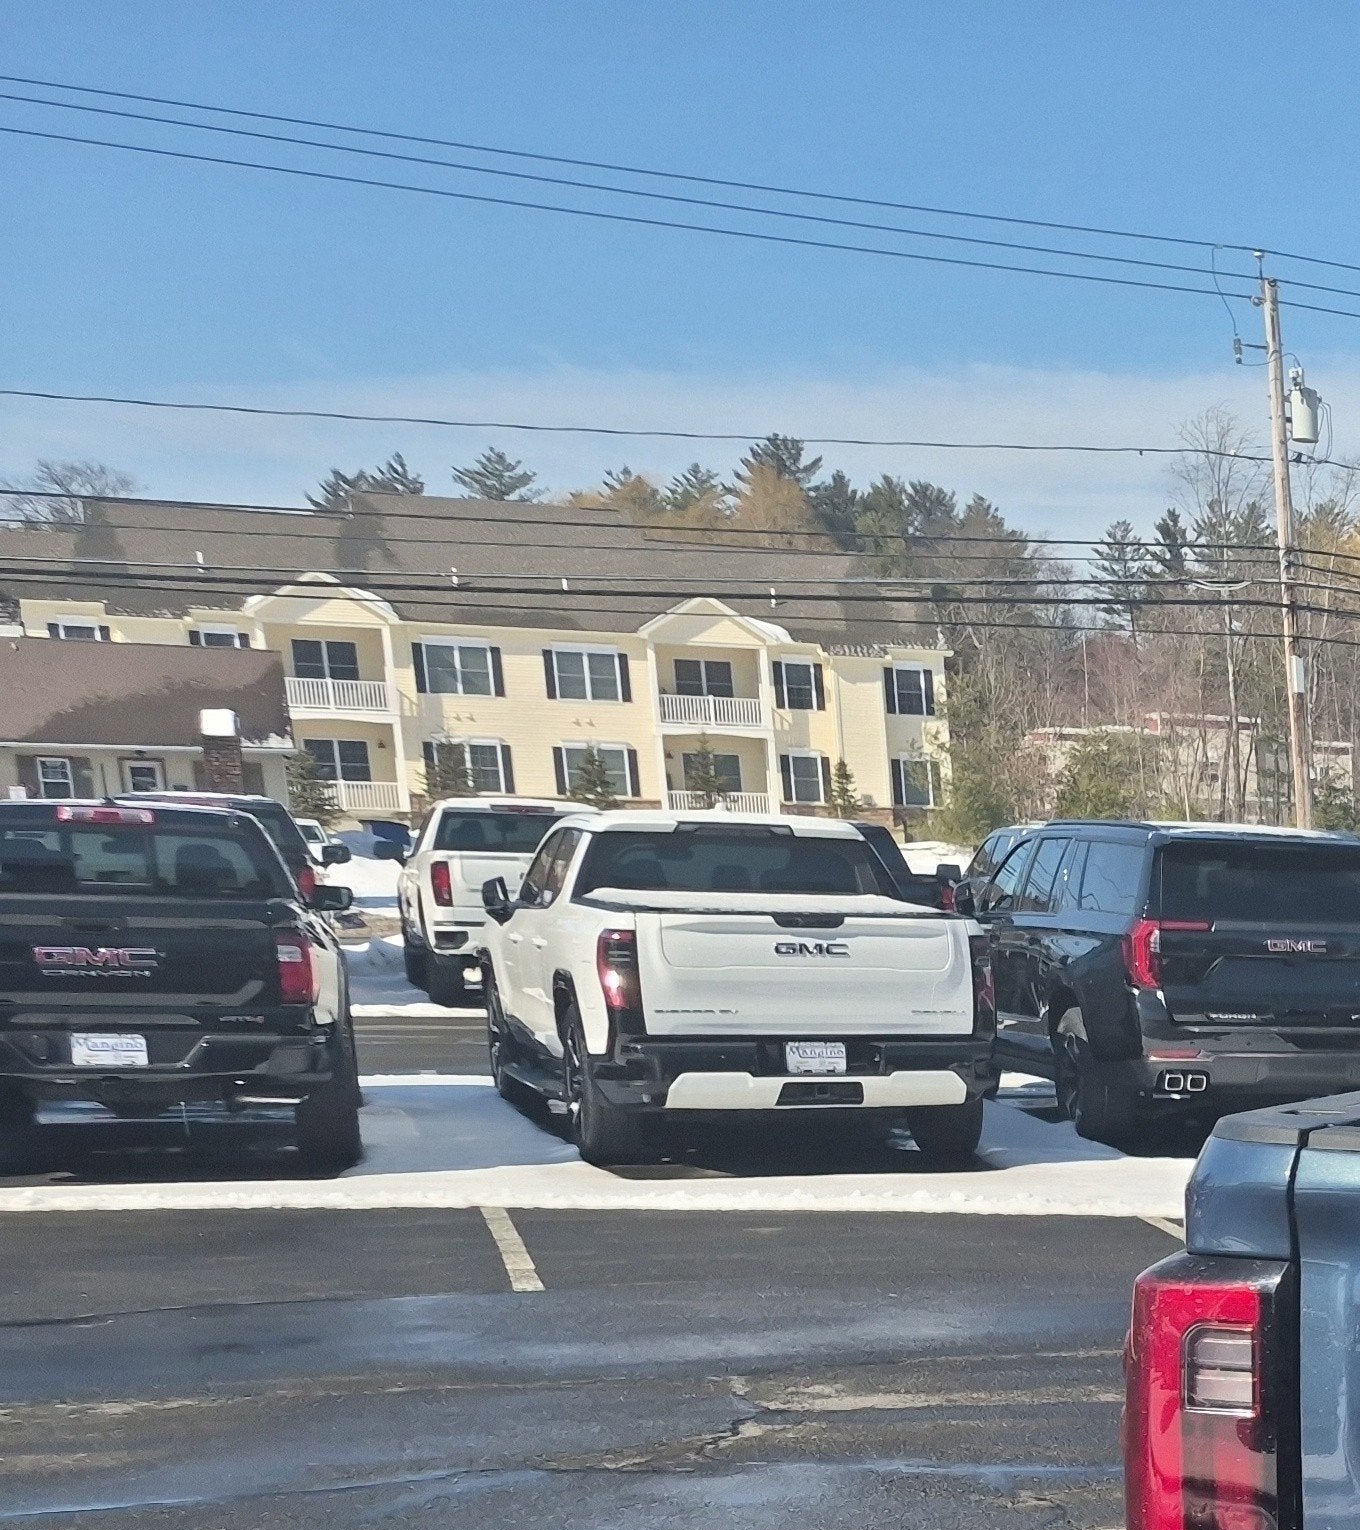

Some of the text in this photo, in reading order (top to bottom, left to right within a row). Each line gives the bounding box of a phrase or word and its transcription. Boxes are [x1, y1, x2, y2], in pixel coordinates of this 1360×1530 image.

[774, 942, 851, 959] GMC
[1266, 939, 1327, 953] GMC
[32, 946, 159, 967] GMC
[40, 969, 152, 977] CANYON
[788, 1046, 846, 1059] Mangino
